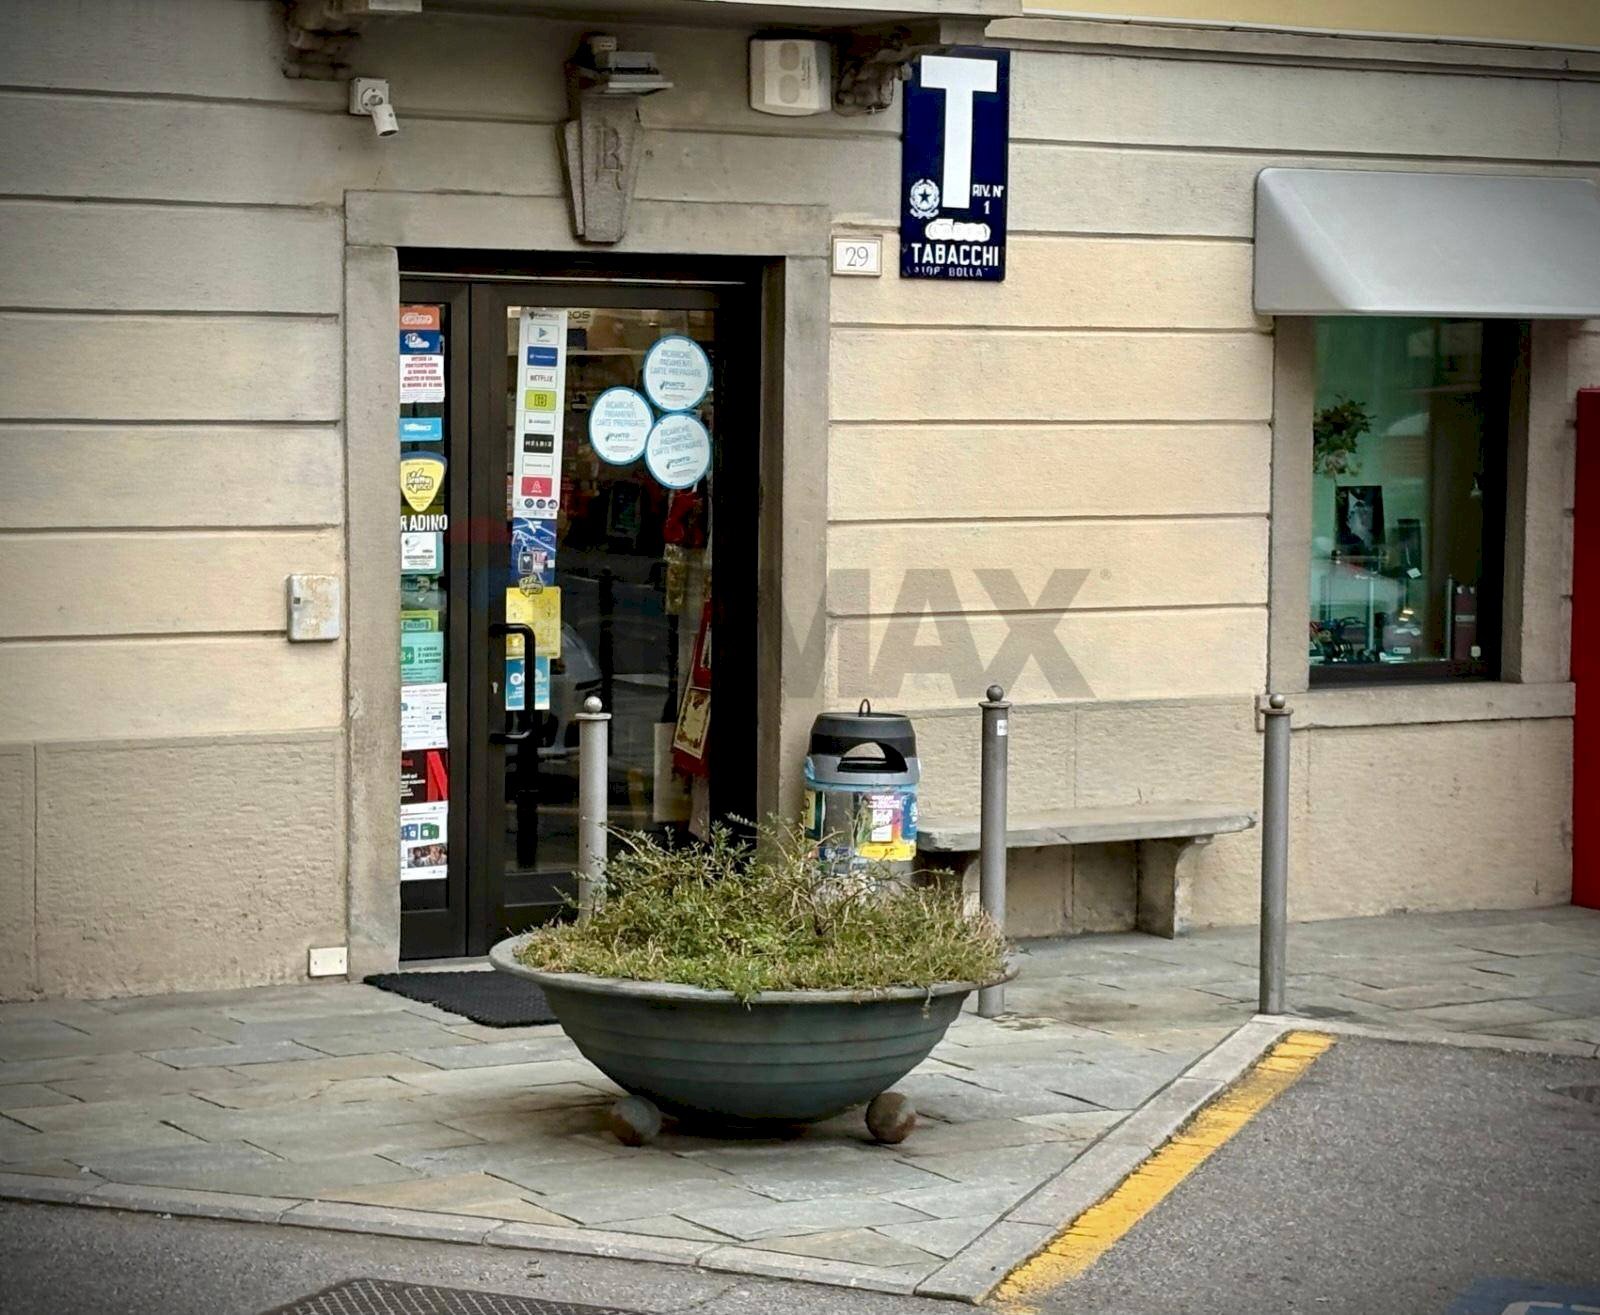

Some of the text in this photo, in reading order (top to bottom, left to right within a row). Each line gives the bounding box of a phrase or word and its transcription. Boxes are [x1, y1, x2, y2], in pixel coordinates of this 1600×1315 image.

[921, 55, 998, 209] T
[983, 200, 990, 214] 1
[845, 246, 870, 267] 29
[910, 242, 999, 267] TABACCHI
